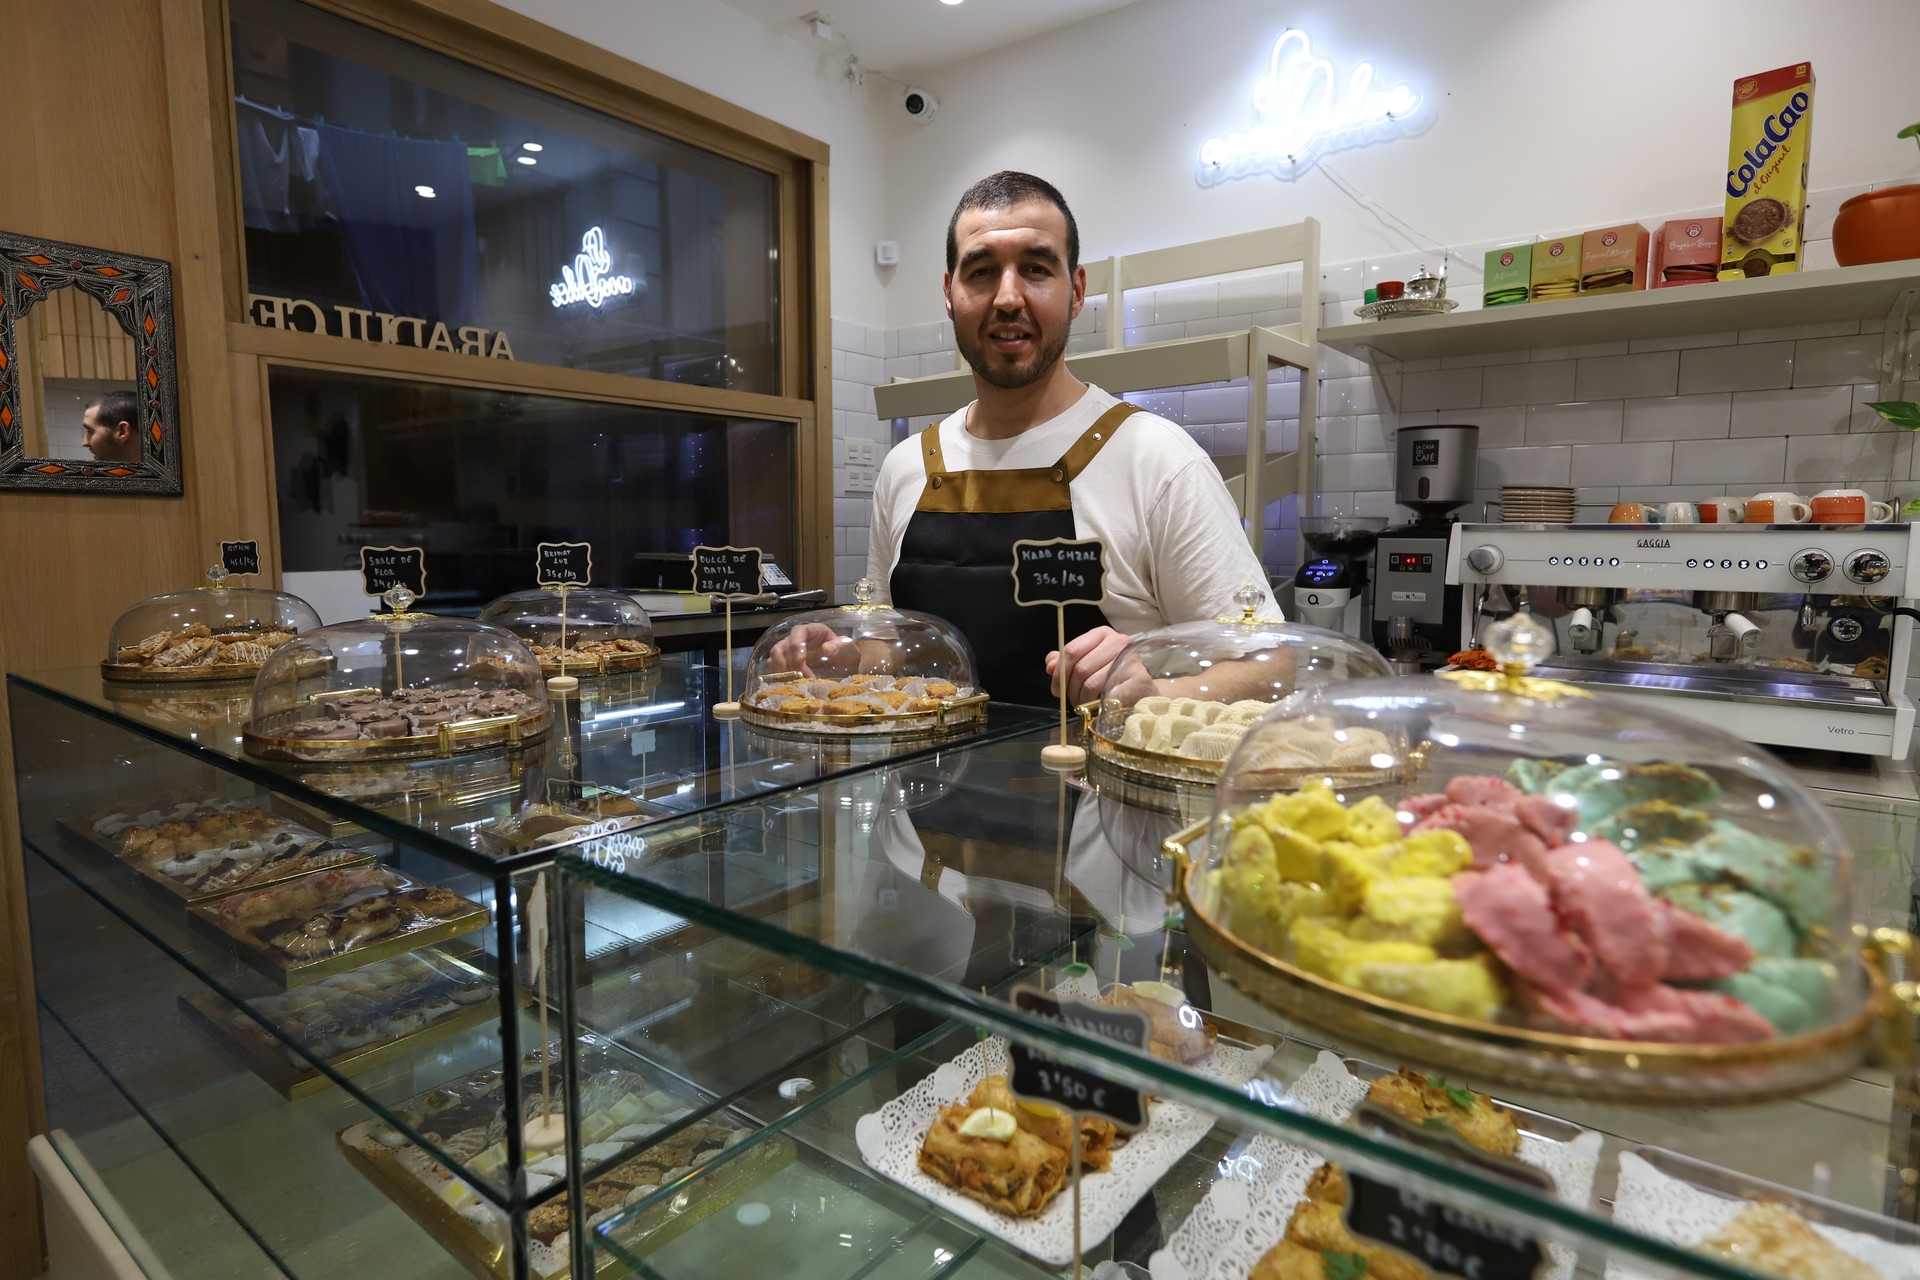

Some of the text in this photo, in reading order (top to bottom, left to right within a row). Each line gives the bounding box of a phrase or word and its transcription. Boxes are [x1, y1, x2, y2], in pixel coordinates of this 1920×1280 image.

[1727, 91, 1809, 199] ColaCao
[1760, 145, 1791, 185] Original
[1416, 453, 1435, 462] CAFÉ
[1637, 539, 1670, 548] GAGGIA
[700, 554, 747, 563] DULCE DE
[374, 568, 395, 576] FLOR
[703, 566, 735, 574] DATIL
[1828, 726, 1855, 735] Vetro
